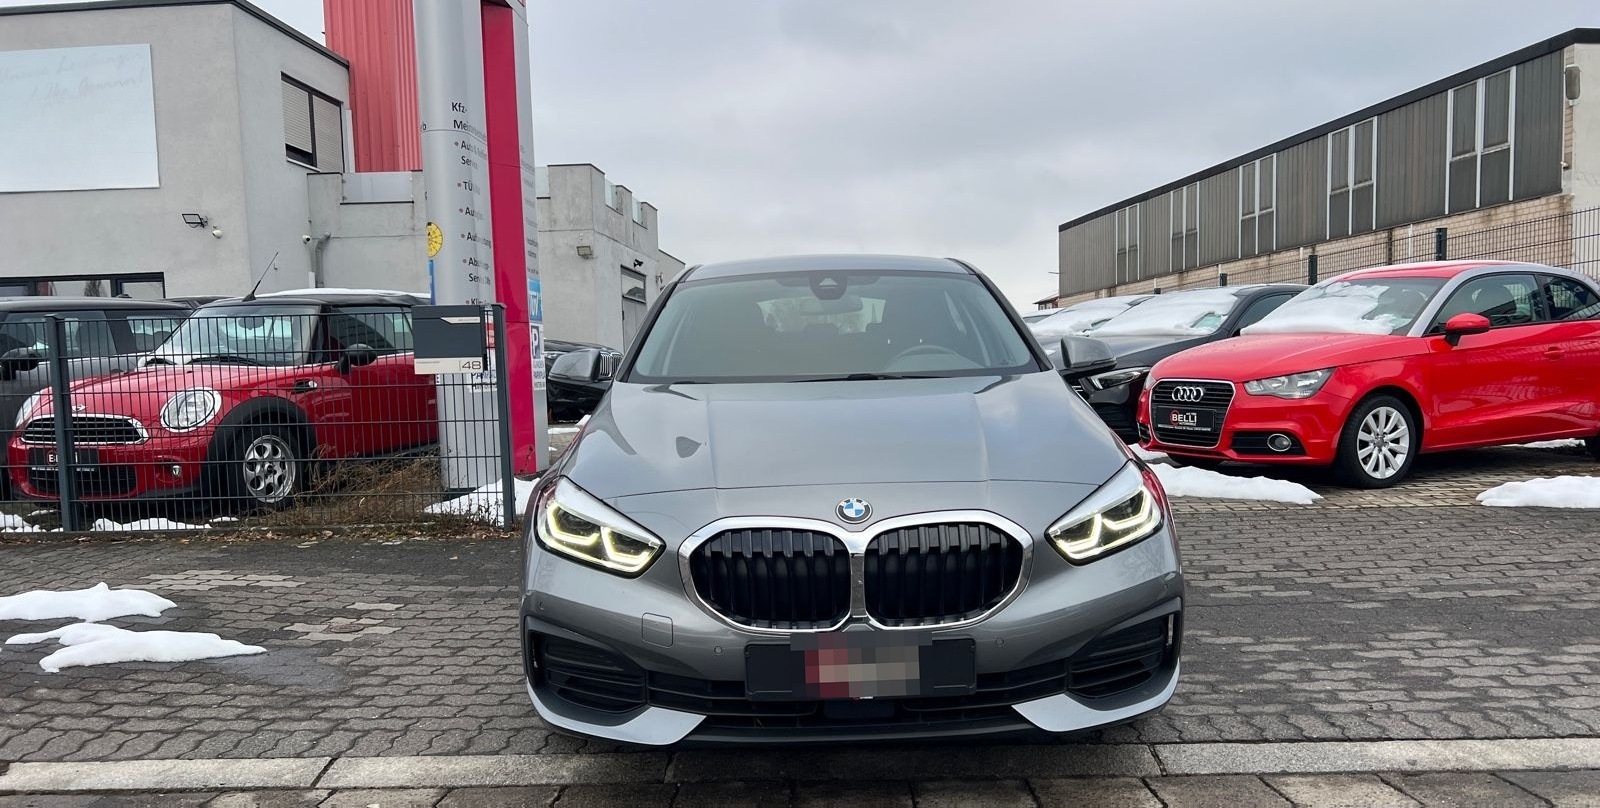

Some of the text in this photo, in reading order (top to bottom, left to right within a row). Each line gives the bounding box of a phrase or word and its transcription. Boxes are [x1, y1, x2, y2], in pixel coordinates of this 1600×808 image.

[451, 102, 467, 113] Kfz-
[461, 360, 482, 370] 48
[1171, 413, 1197, 422] BELLI
